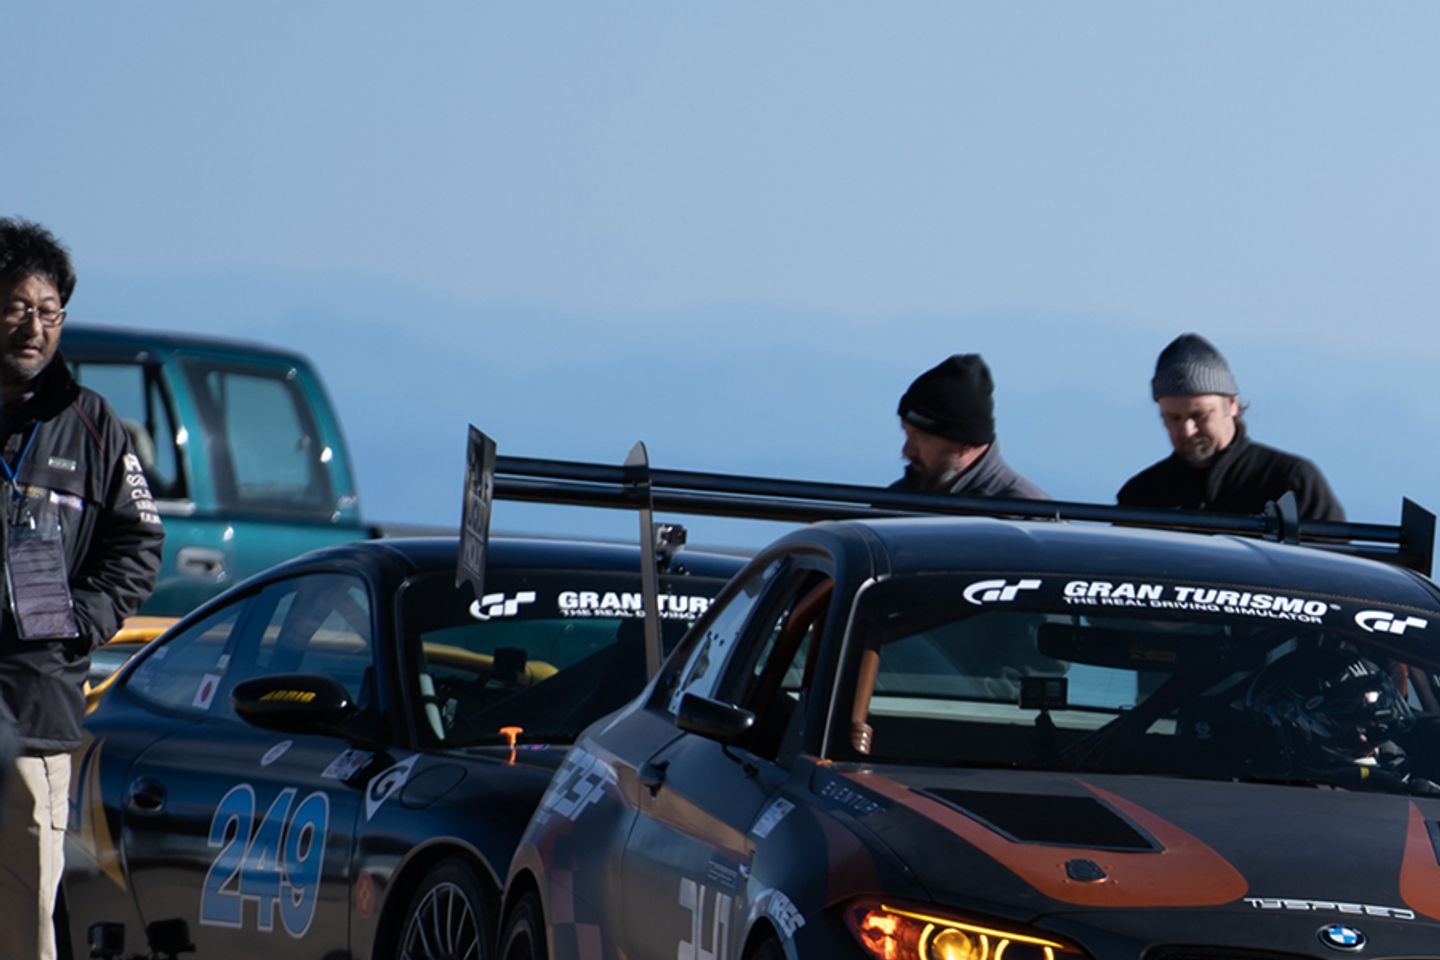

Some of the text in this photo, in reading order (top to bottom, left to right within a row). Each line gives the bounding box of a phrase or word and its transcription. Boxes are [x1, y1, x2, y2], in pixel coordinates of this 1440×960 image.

[557, 590, 641, 612] GRAN
[1063, 580, 1328, 616] GRAN TURISMO
[1063, 596, 1323, 624] THE REAL DRIVING SIMULATOR
[200, 783, 330, 940] 249
